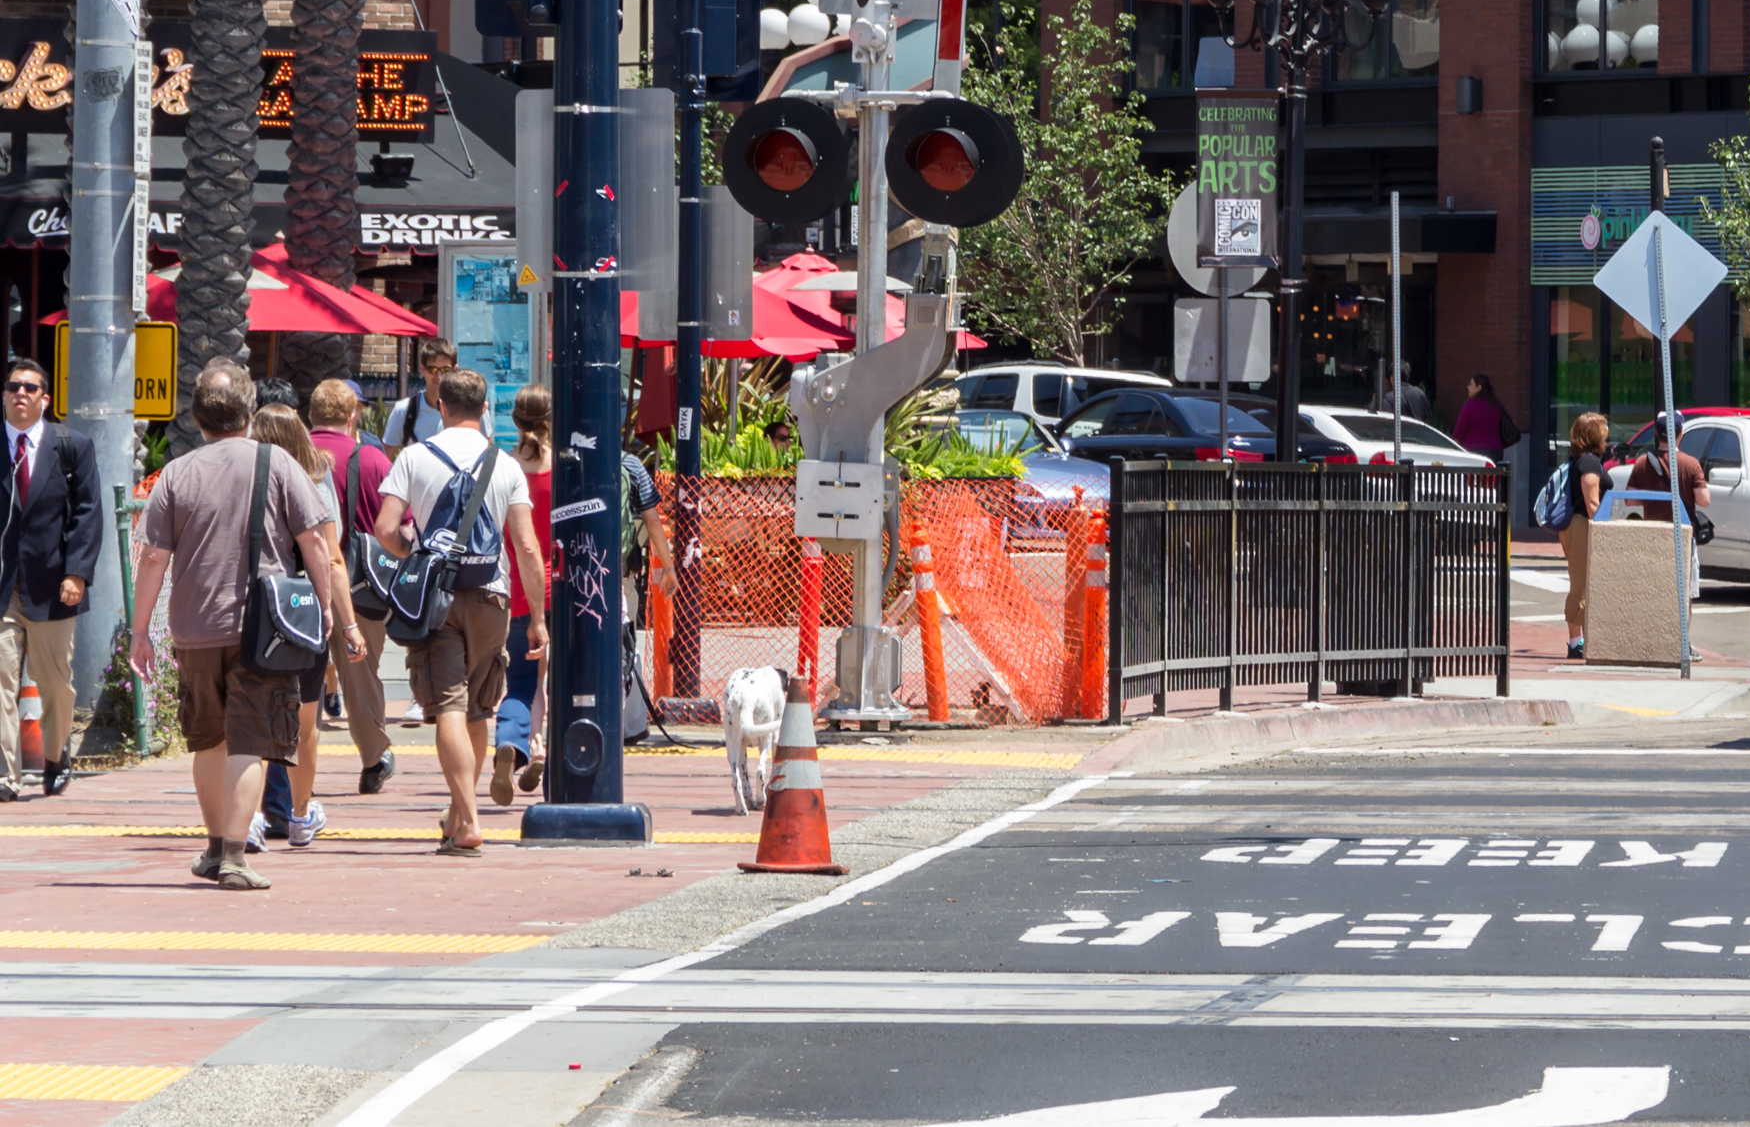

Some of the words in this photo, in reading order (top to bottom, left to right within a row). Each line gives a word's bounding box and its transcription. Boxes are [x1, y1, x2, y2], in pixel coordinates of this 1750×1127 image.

[357, 63, 403, 89] HE
[1198, 107, 1277, 122] CELEBRATING
[1230, 124, 1246, 133] THE
[1199, 134, 1277, 158] POPULAR
[1198, 160, 1277, 194] ARTS
[361, 214, 499, 231] EXOTIC
[1232, 207, 1258, 220] CON
[1218, 206, 1231, 247] COMIC
[134, 377, 167, 400] ORN
[680, 409, 689, 438] CMYK
[386, 560, 399, 570] esri
[407, 573, 420, 583] esri
[300, 593, 314, 605] esri
[1201, 837, 1729, 868] KEEP
